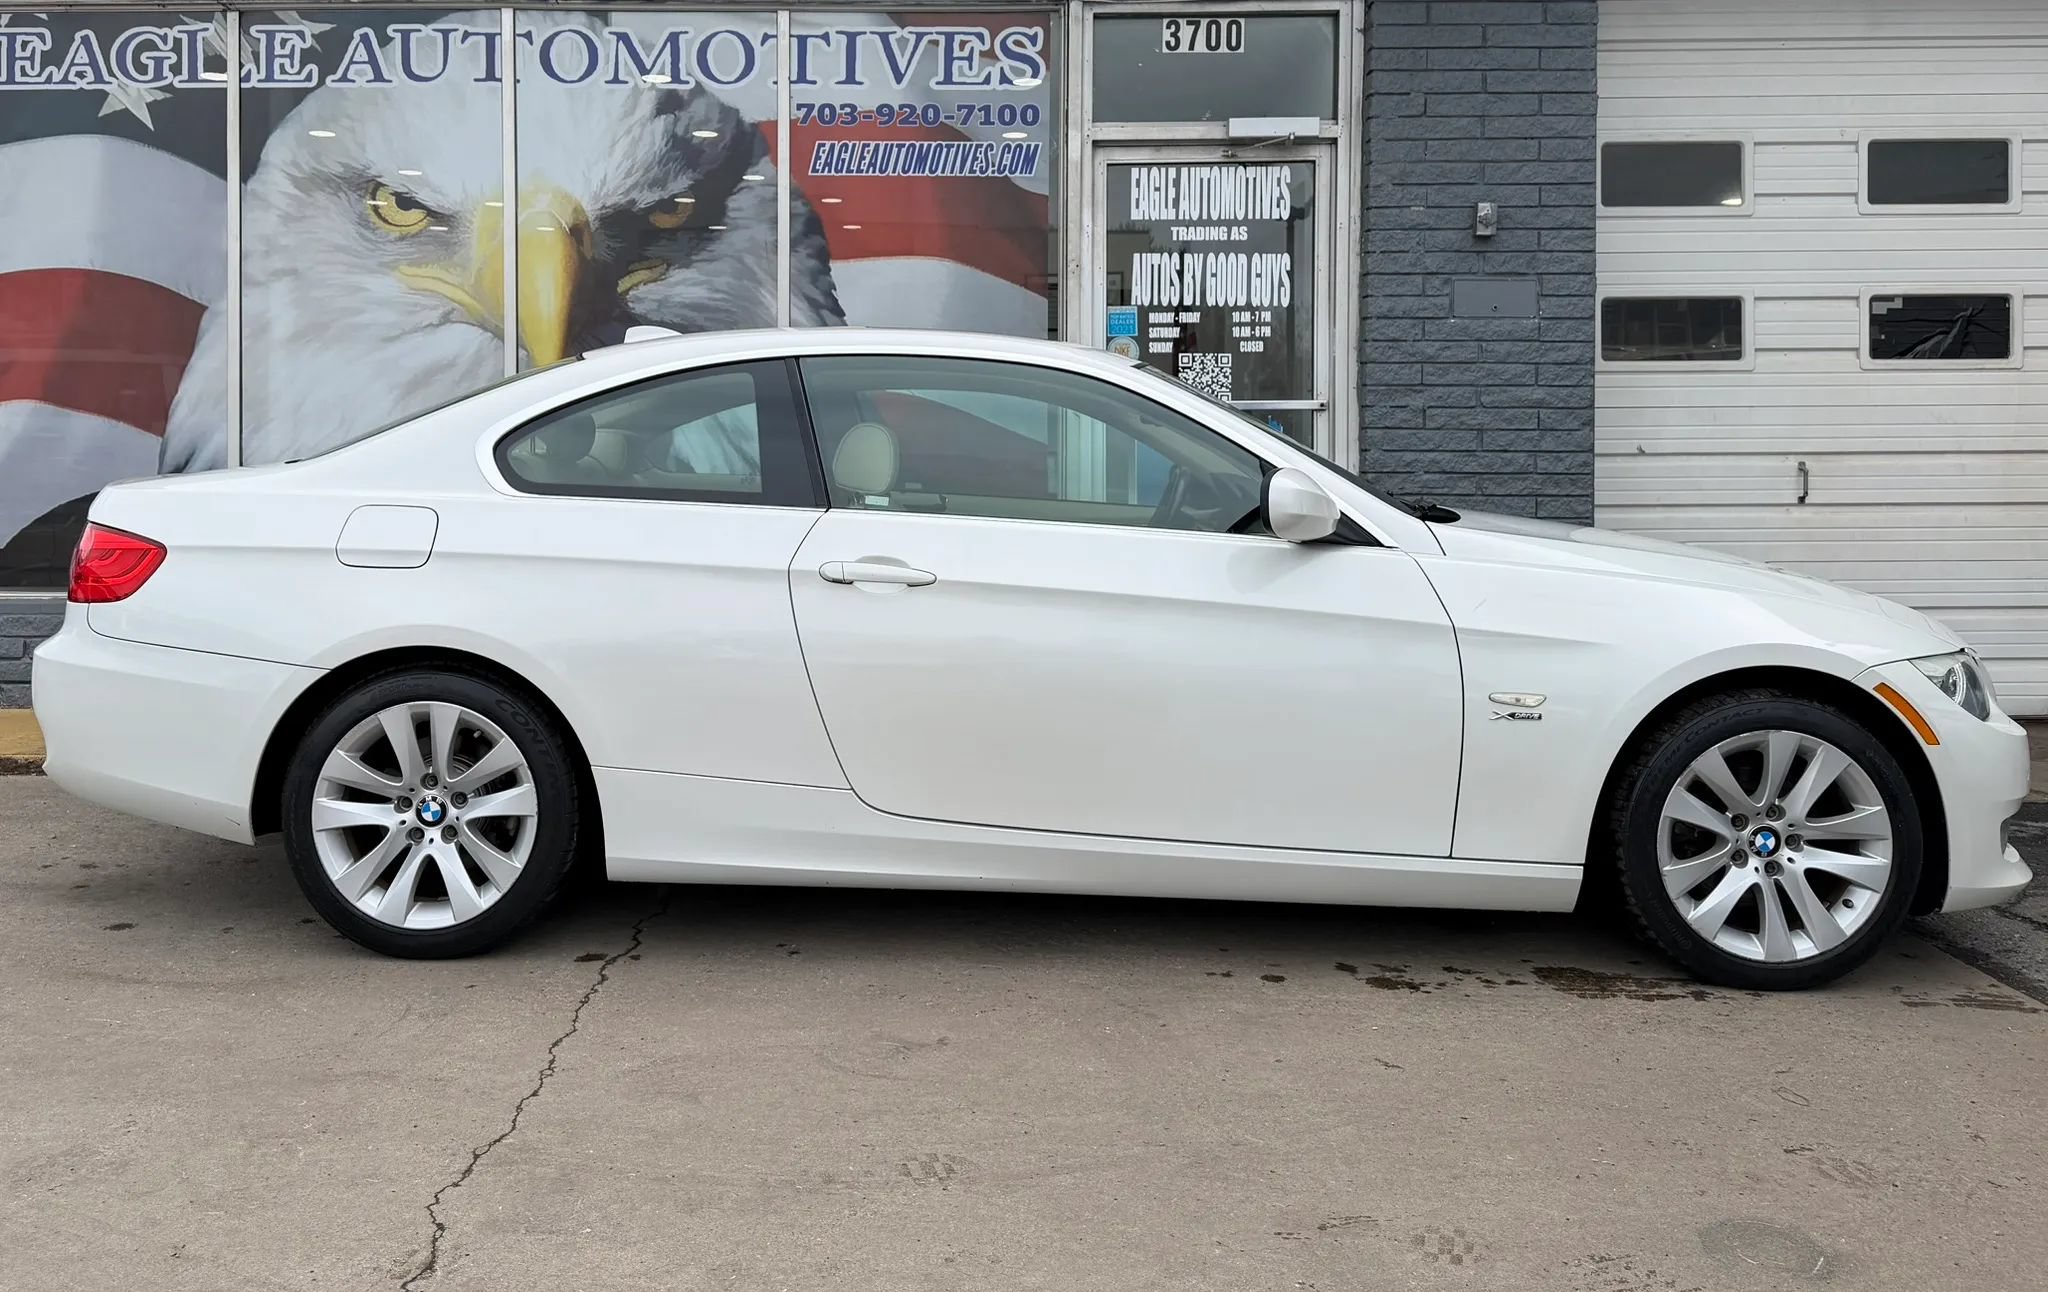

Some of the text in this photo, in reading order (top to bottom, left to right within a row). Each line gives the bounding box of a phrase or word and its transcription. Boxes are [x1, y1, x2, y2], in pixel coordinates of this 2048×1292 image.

[1164, 18, 1243, 52] 3700
[0, 24, 1048, 90] EAGLE AUTOMOTIVES
[796, 102, 1041, 127] 703-920-7100
[808, 140, 1042, 177] EAGLEAUTOMOTIVES.COM
[1130, 166, 1292, 221] EAGLE AUTOMOTIVES
[1171, 226, 1248, 241] TRADING AS
[1131, 251, 1292, 308] AUTOS BY GOOD GUYS
[1148, 311, 1175, 323] MONDAY
[1179, 311, 1201, 323] FRIDAY
[1232, 311, 1240, 322] 10
[1240, 311, 1251, 322] AM
[1255, 311, 1260, 322] 7
[1261, 311, 1272, 322] PM
[1148, 326, 1180, 338] SATURDAY
[1232, 326, 1240, 337] 10
[1240, 326, 1251, 337] AM
[1261, 326, 1272, 337] PM
[1148, 341, 1264, 353] SUNDAY CLOSED
